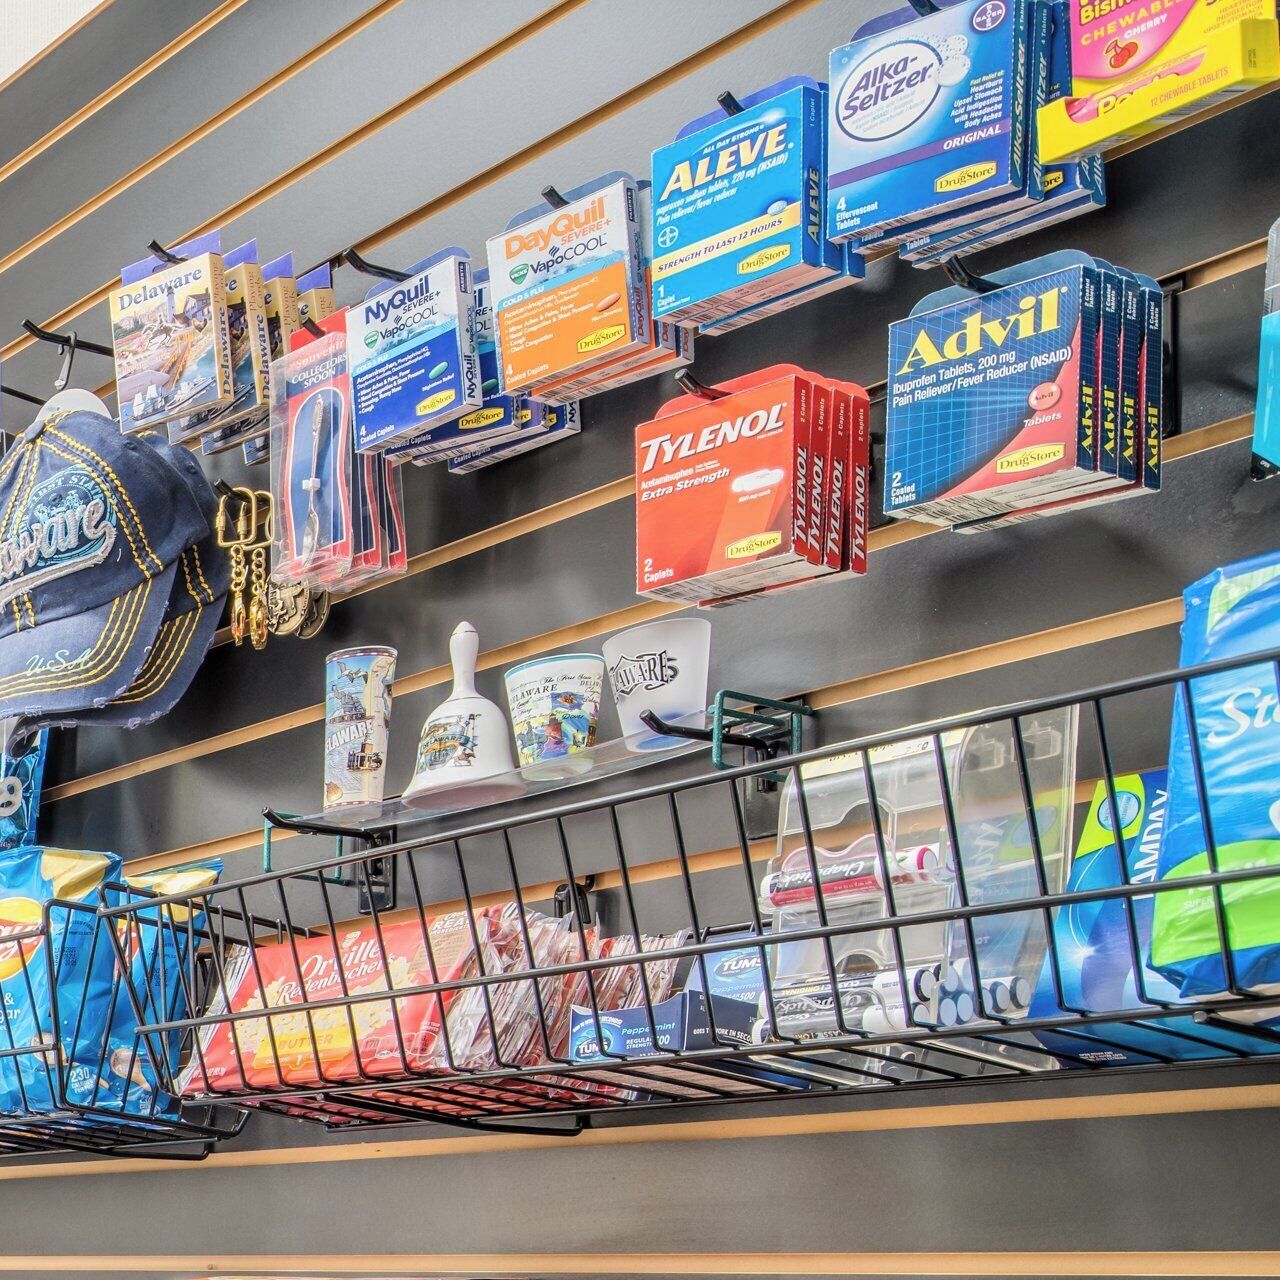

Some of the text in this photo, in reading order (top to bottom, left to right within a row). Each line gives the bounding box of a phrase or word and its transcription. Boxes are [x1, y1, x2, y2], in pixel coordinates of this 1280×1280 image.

[1124, 13, 1168, 39] CHERRY
[842, 61, 934, 121] Seltzer
[848, 55, 918, 99] Alka-
[970, 78, 1004, 93] Heartburn
[1151, 67, 1229, 108] 12 CHEWABLE TABLETS
[965, 94, 1002, 112] Indigestion
[968, 102, 1002, 119] Headache
[943, 125, 1002, 150] ORIGINAL
[659, 123, 788, 202] ALEVE
[505, 197, 605, 260] DayQuil
[836, 202, 878, 220] Effervescent
[530, 235, 607, 275] VapoCOOL
[658, 217, 783, 273] STRENGTH LAST HOURS
[118, 267, 203, 312] Delaware
[364, 277, 430, 325] NyQuil
[379, 303, 438, 340] VapoCOOL
[579, 327, 623, 349] DrugStore
[895, 288, 1061, 376] Advil
[220, 306, 231, 396] Delaware
[291, 353, 347, 385] COLLECTORS
[303, 370, 336, 388] SPOON
[892, 354, 996, 396] Ibuprofen Tablets, 200
[892, 346, 1072, 409] Pain Reliever/Fever Reducer (NSAID)
[360, 424, 366, 437] 4
[1023, 410, 1062, 428] Tablets
[1081, 385, 1093, 456] Advil
[1103, 389, 1115, 458] Advil
[1123, 396, 1136, 464] Advil
[641, 403, 785, 474] TYLENOL
[641, 467, 694, 490] Acetaminophen
[641, 467, 730, 502] Extra Strength
[891, 483, 915, 497] Coated
[644, 558, 652, 572] 2
[644, 569, 674, 583] Caplets
[723, 955, 764, 970] TUMS
[739, 992, 756, 1000] 500
[70, 1068, 89, 1083] 230
